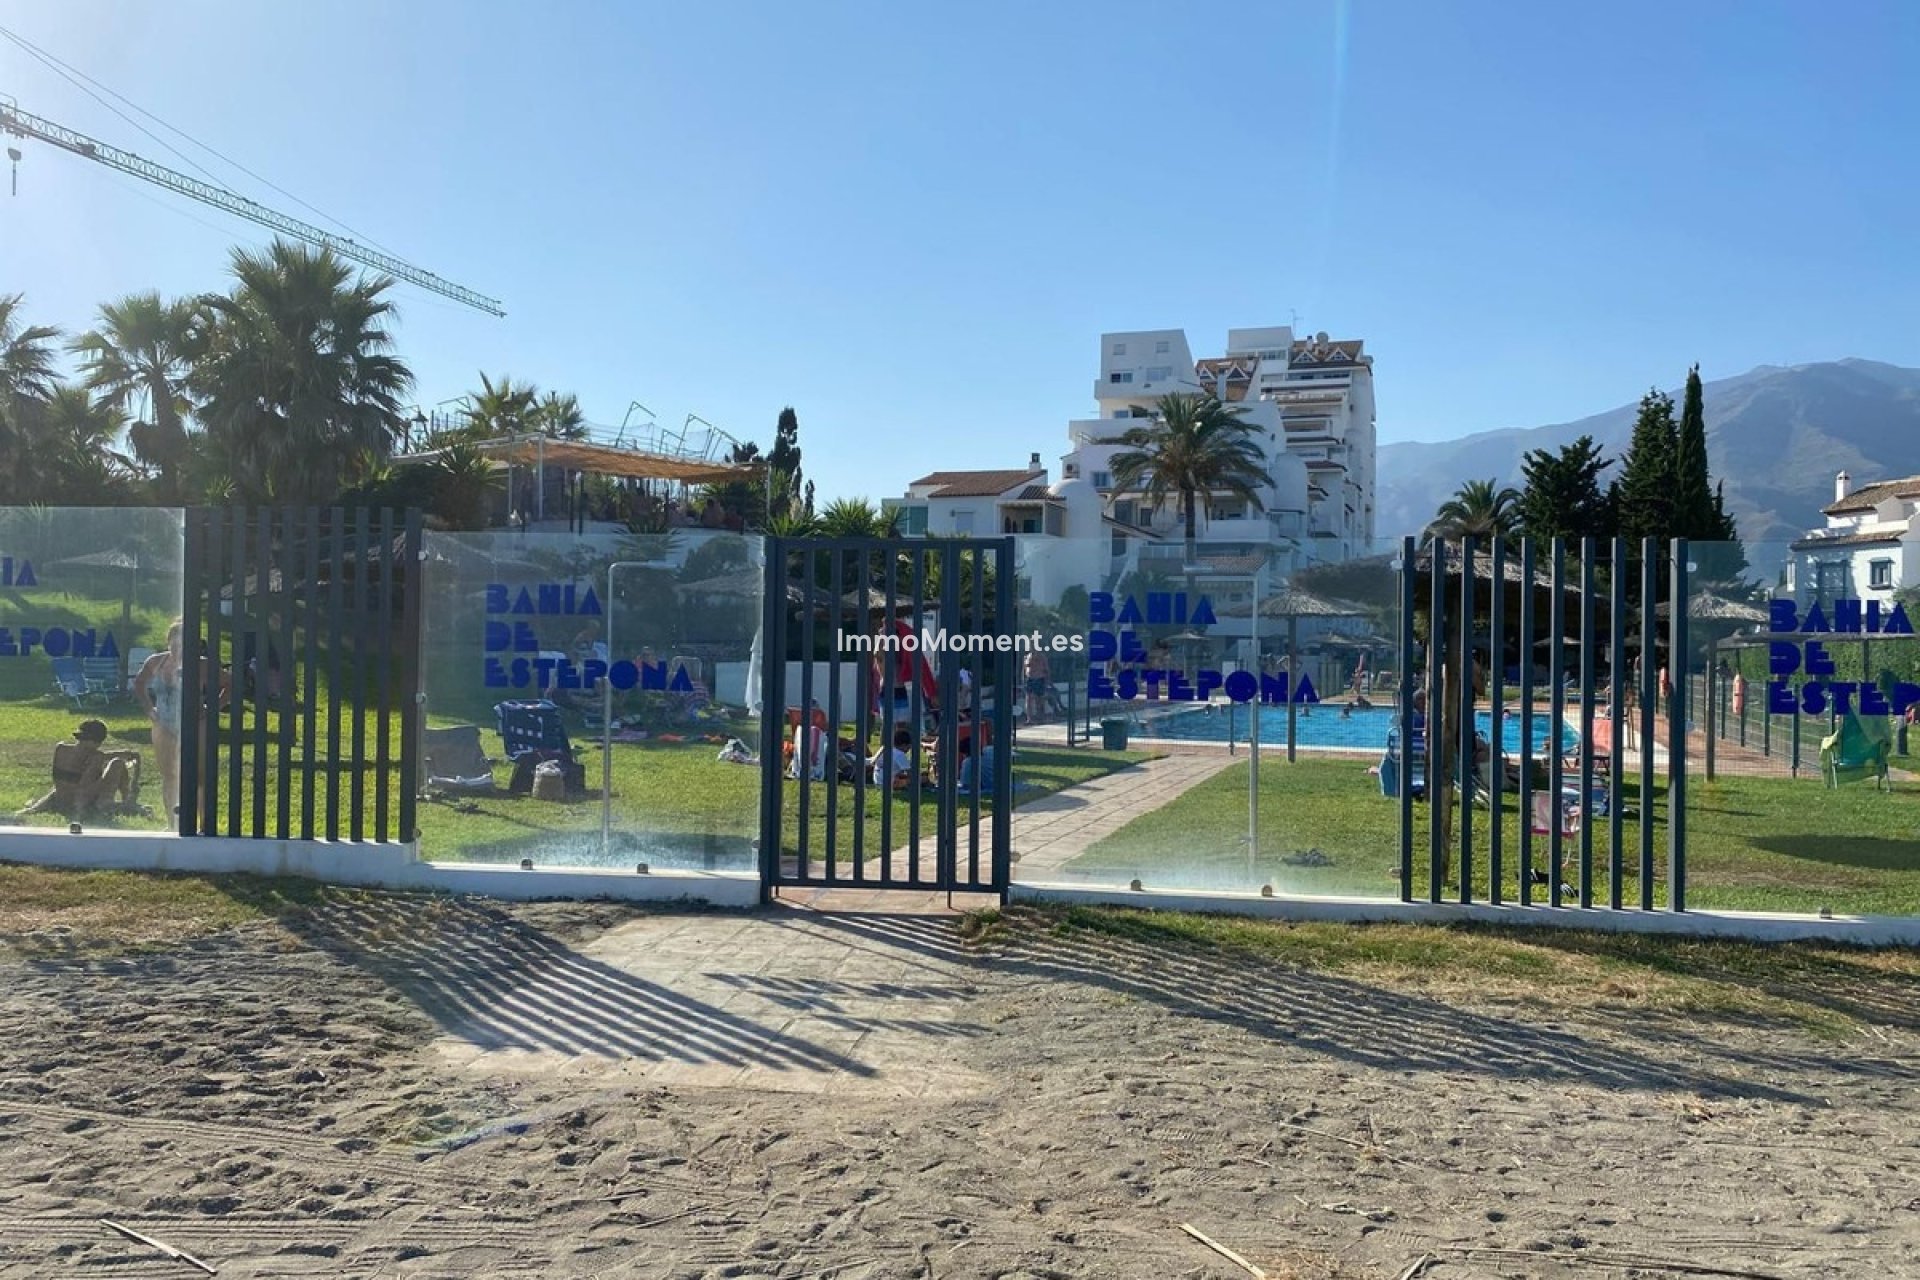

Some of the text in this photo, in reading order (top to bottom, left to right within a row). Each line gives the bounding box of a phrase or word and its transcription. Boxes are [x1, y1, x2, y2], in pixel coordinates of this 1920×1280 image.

[486, 584, 602, 615] BAHIA
[1089, 591, 1217, 624] BAHIA
[1769, 599, 1915, 633] BAHIA
[485, 621, 538, 653] DE
[1089, 630, 1147, 663] DE
[1769, 641, 1835, 675] DE
[485, 658, 694, 692] ESTEPONA
[1088, 668, 1321, 704] ESTEPONA
